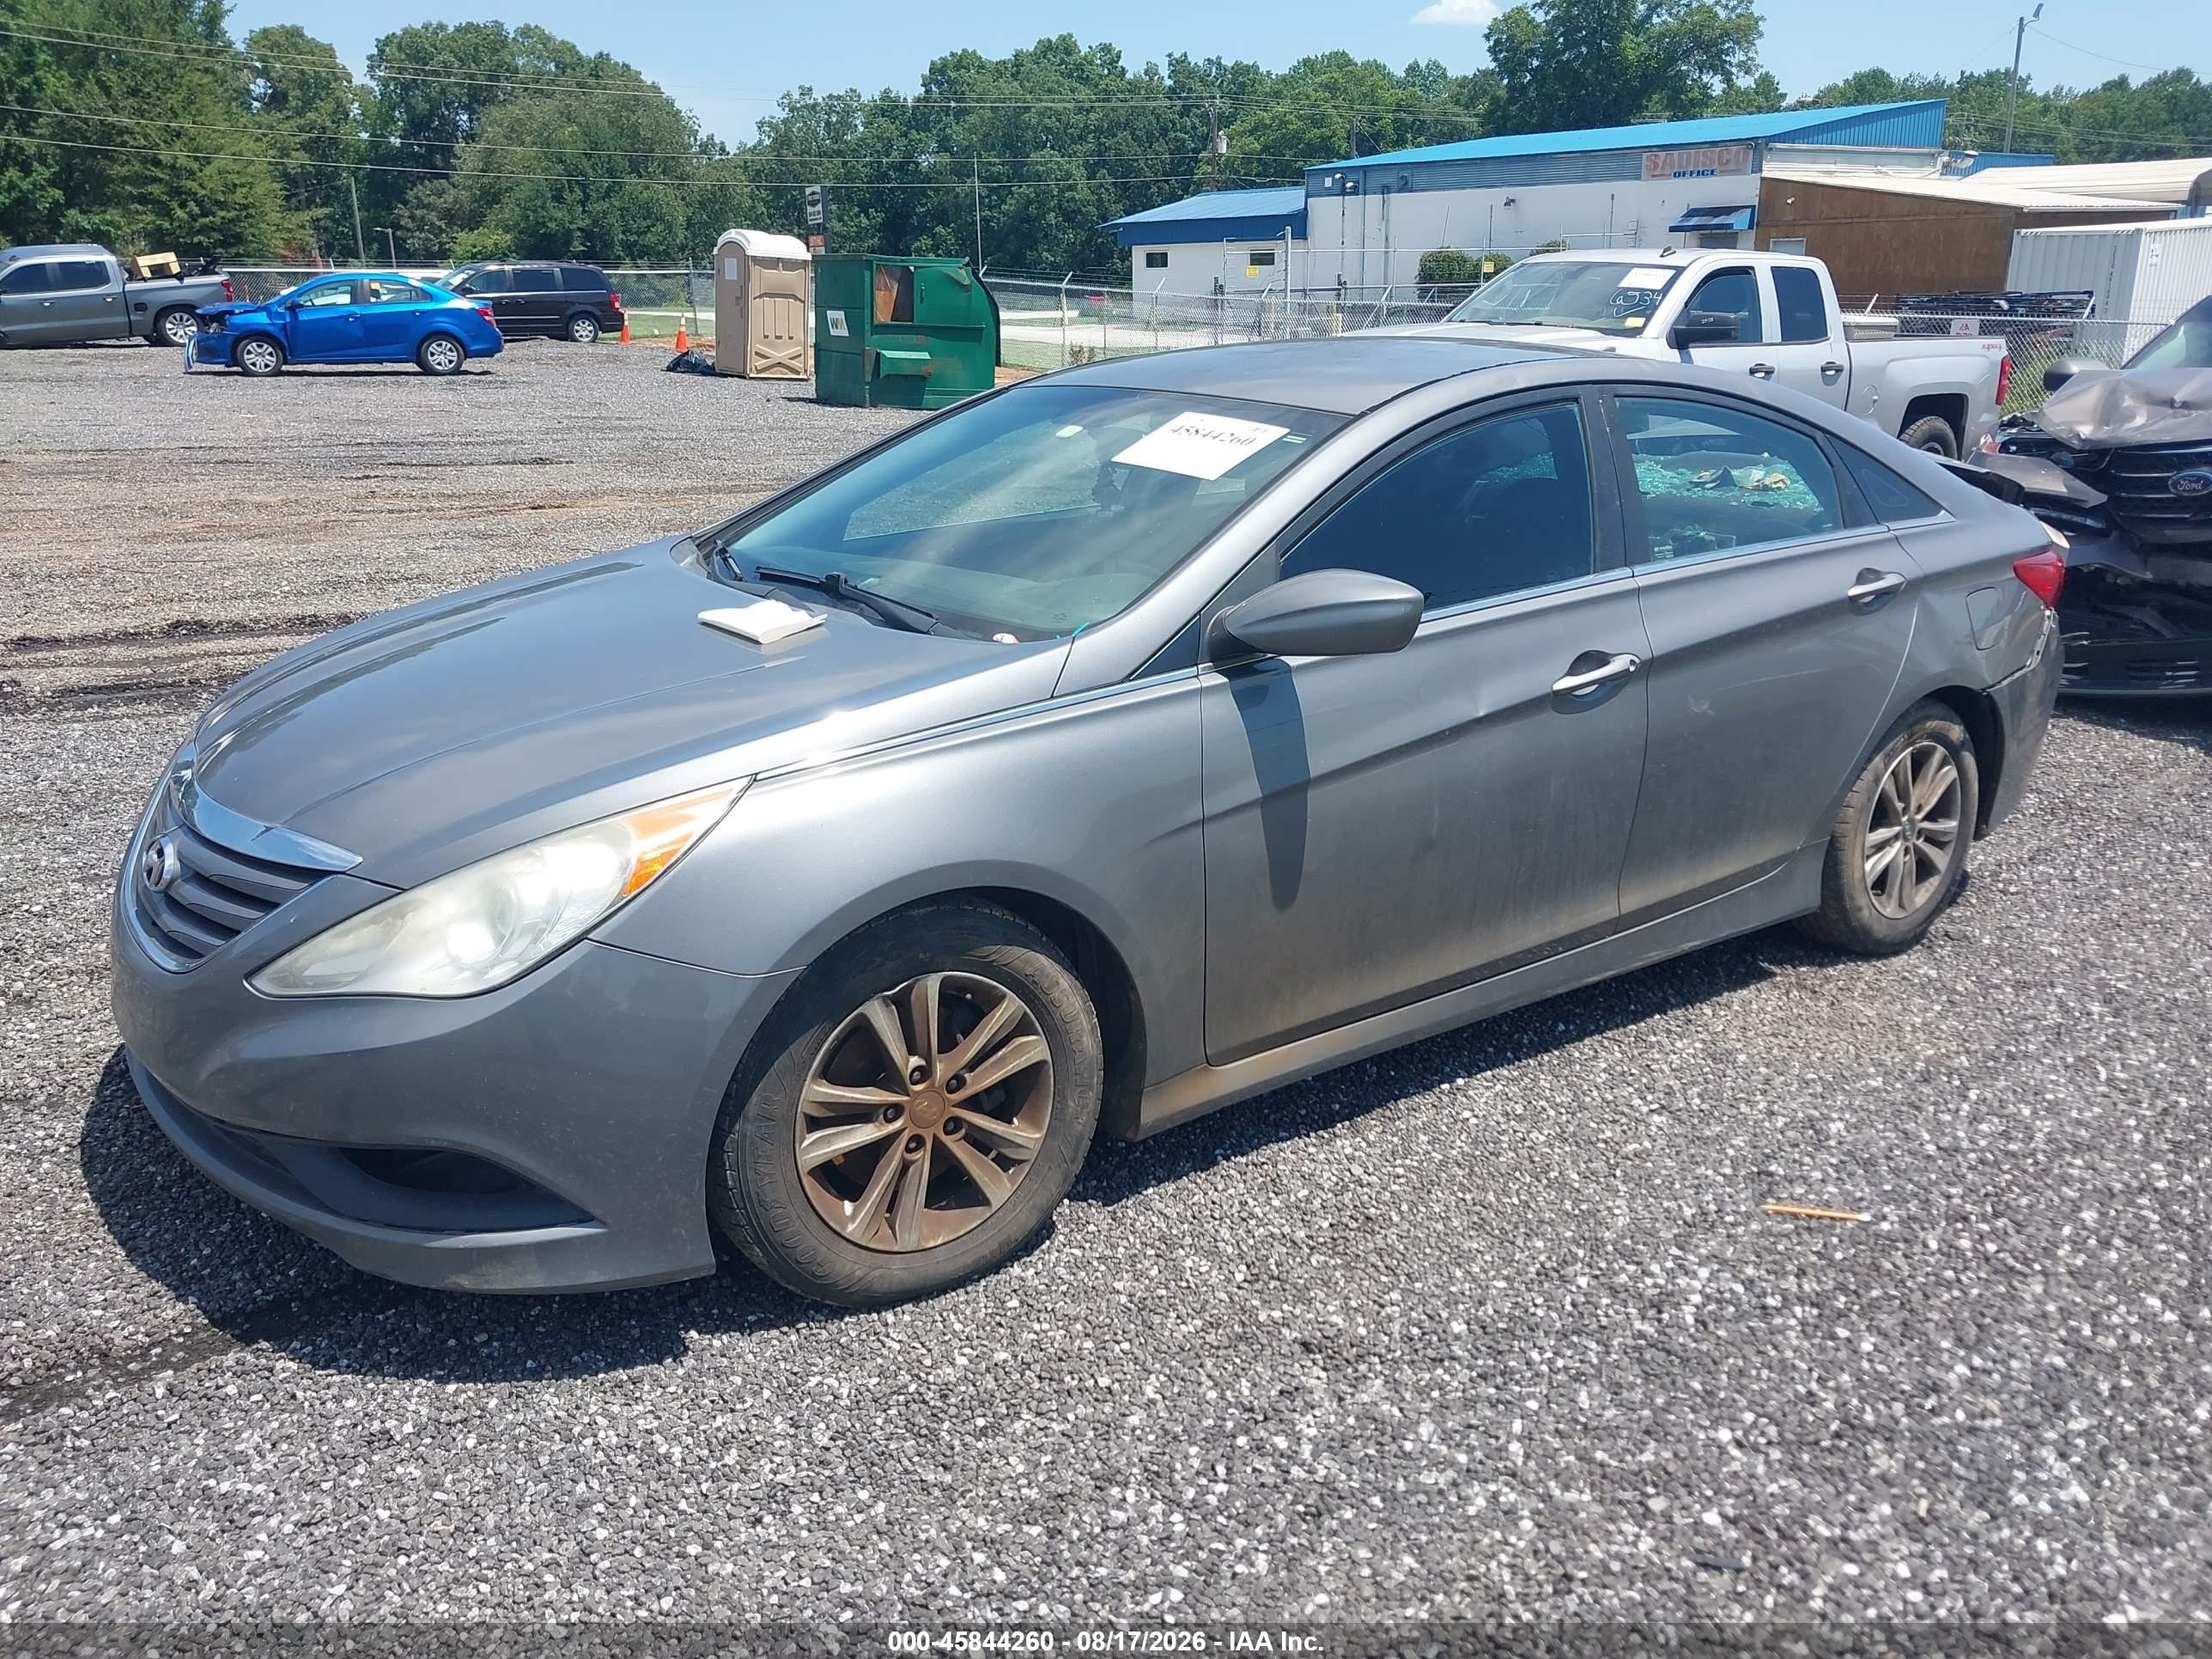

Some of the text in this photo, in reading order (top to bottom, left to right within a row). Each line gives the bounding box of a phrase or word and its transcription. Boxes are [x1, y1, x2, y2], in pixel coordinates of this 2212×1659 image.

[1645, 148, 1751, 171] SADISCO
[1673, 168, 1718, 179] OFFICE
[830, 317, 846, 331] WM
[1170, 425, 1257, 446] 45844260
[2177, 480, 2204, 490] Ford
